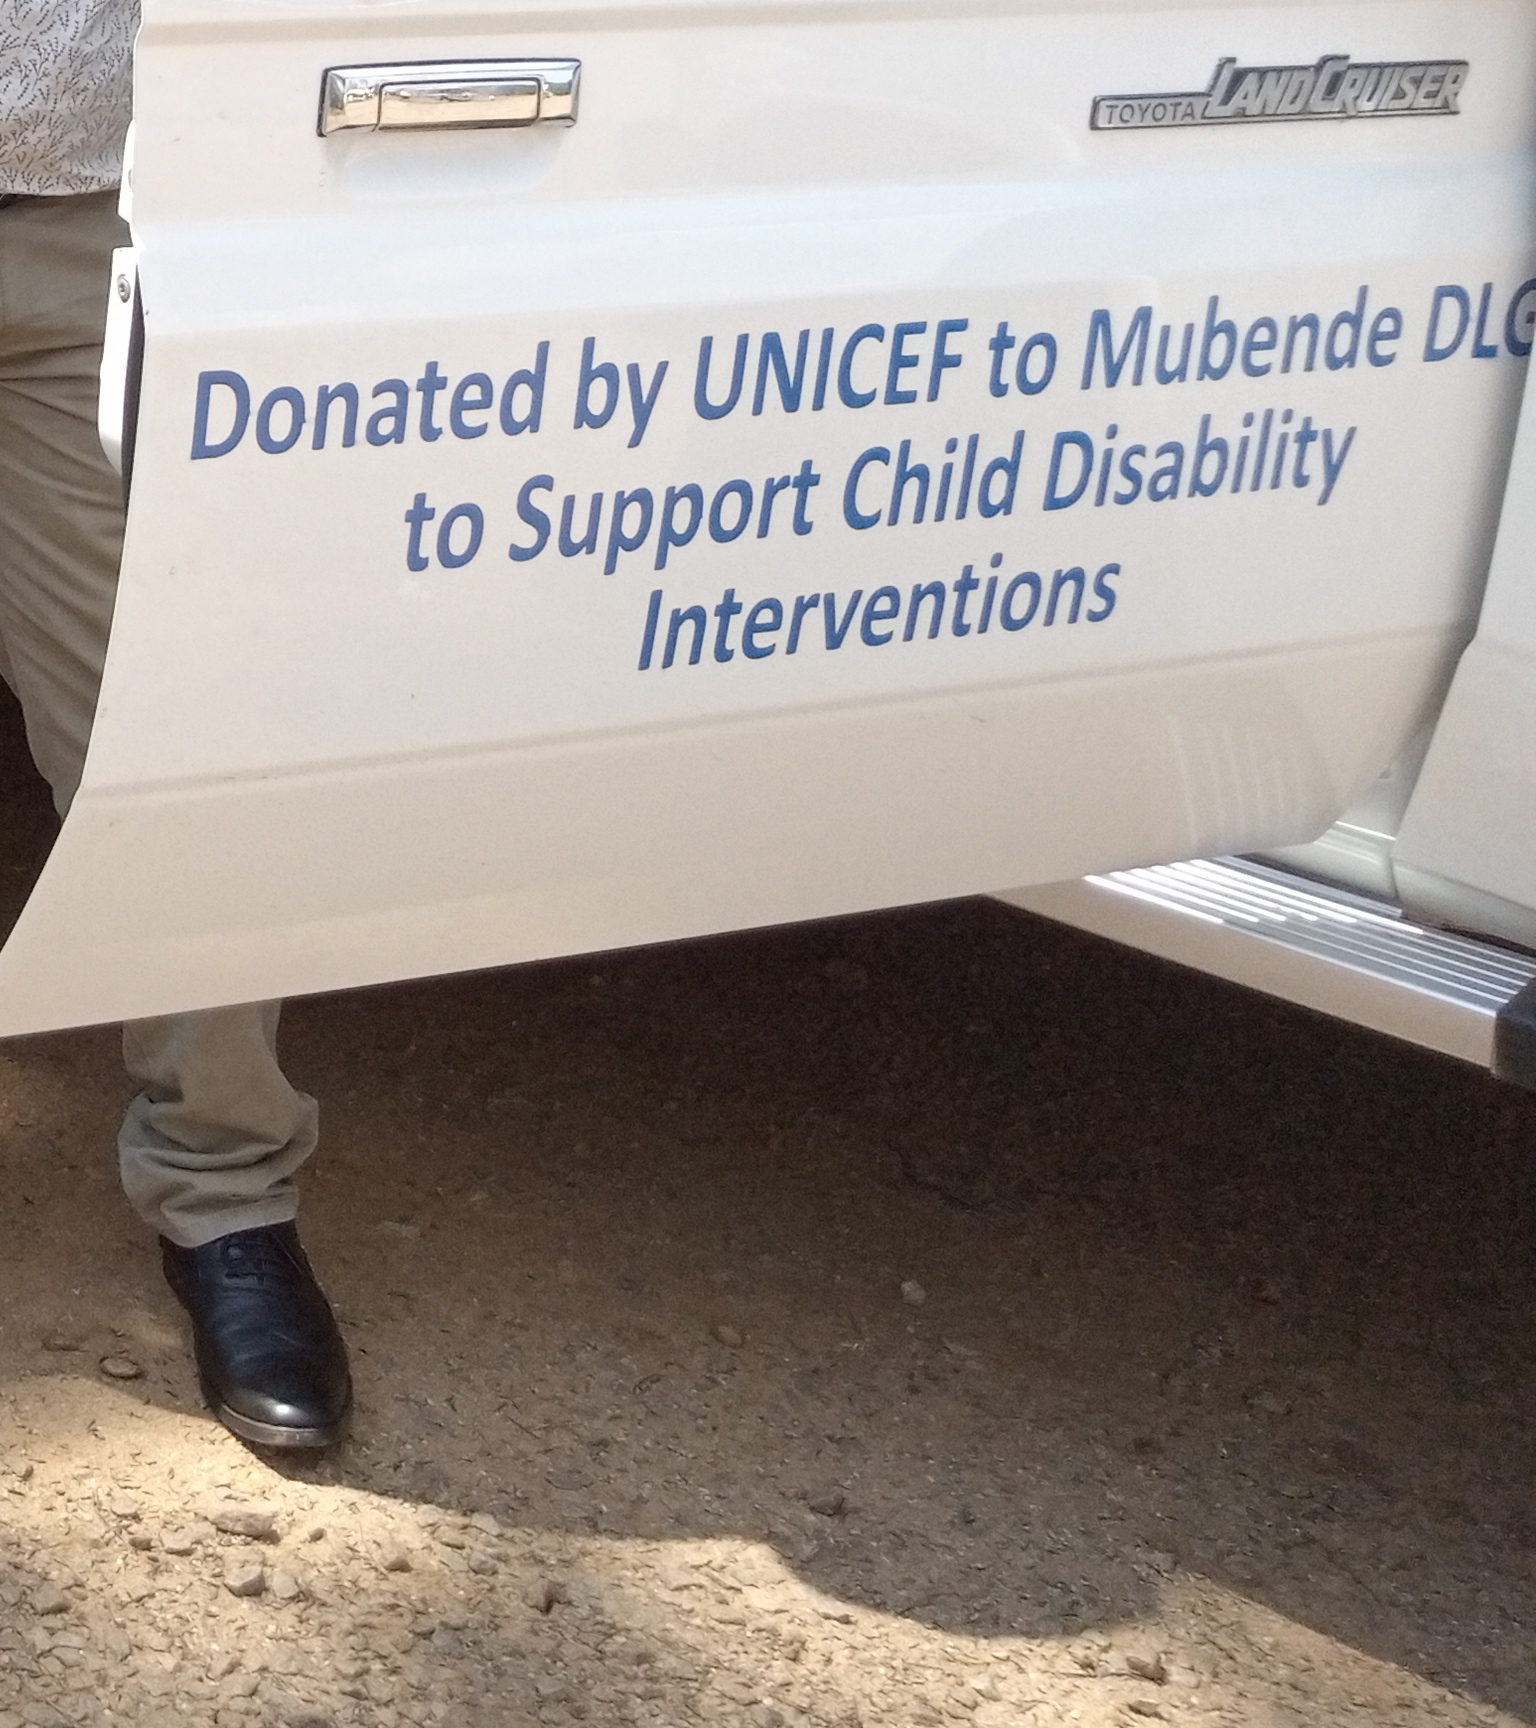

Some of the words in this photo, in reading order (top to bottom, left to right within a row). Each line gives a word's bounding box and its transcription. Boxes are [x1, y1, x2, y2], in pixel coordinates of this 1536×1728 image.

[1106, 101, 1196, 124] TOYOTA
[190, 339, 549, 459] Donated
[574, 336, 668, 447] by
[694, 318, 969, 419] UNICEF
[988, 321, 1058, 397] to
[1080, 286, 1402, 390] Mubende
[404, 492, 484, 571] to
[508, 473, 822, 575] Support
[842, 428, 1025, 530] Child
[1042, 408, 1356, 511] Disability
[638, 552, 1121, 670] Interventions
